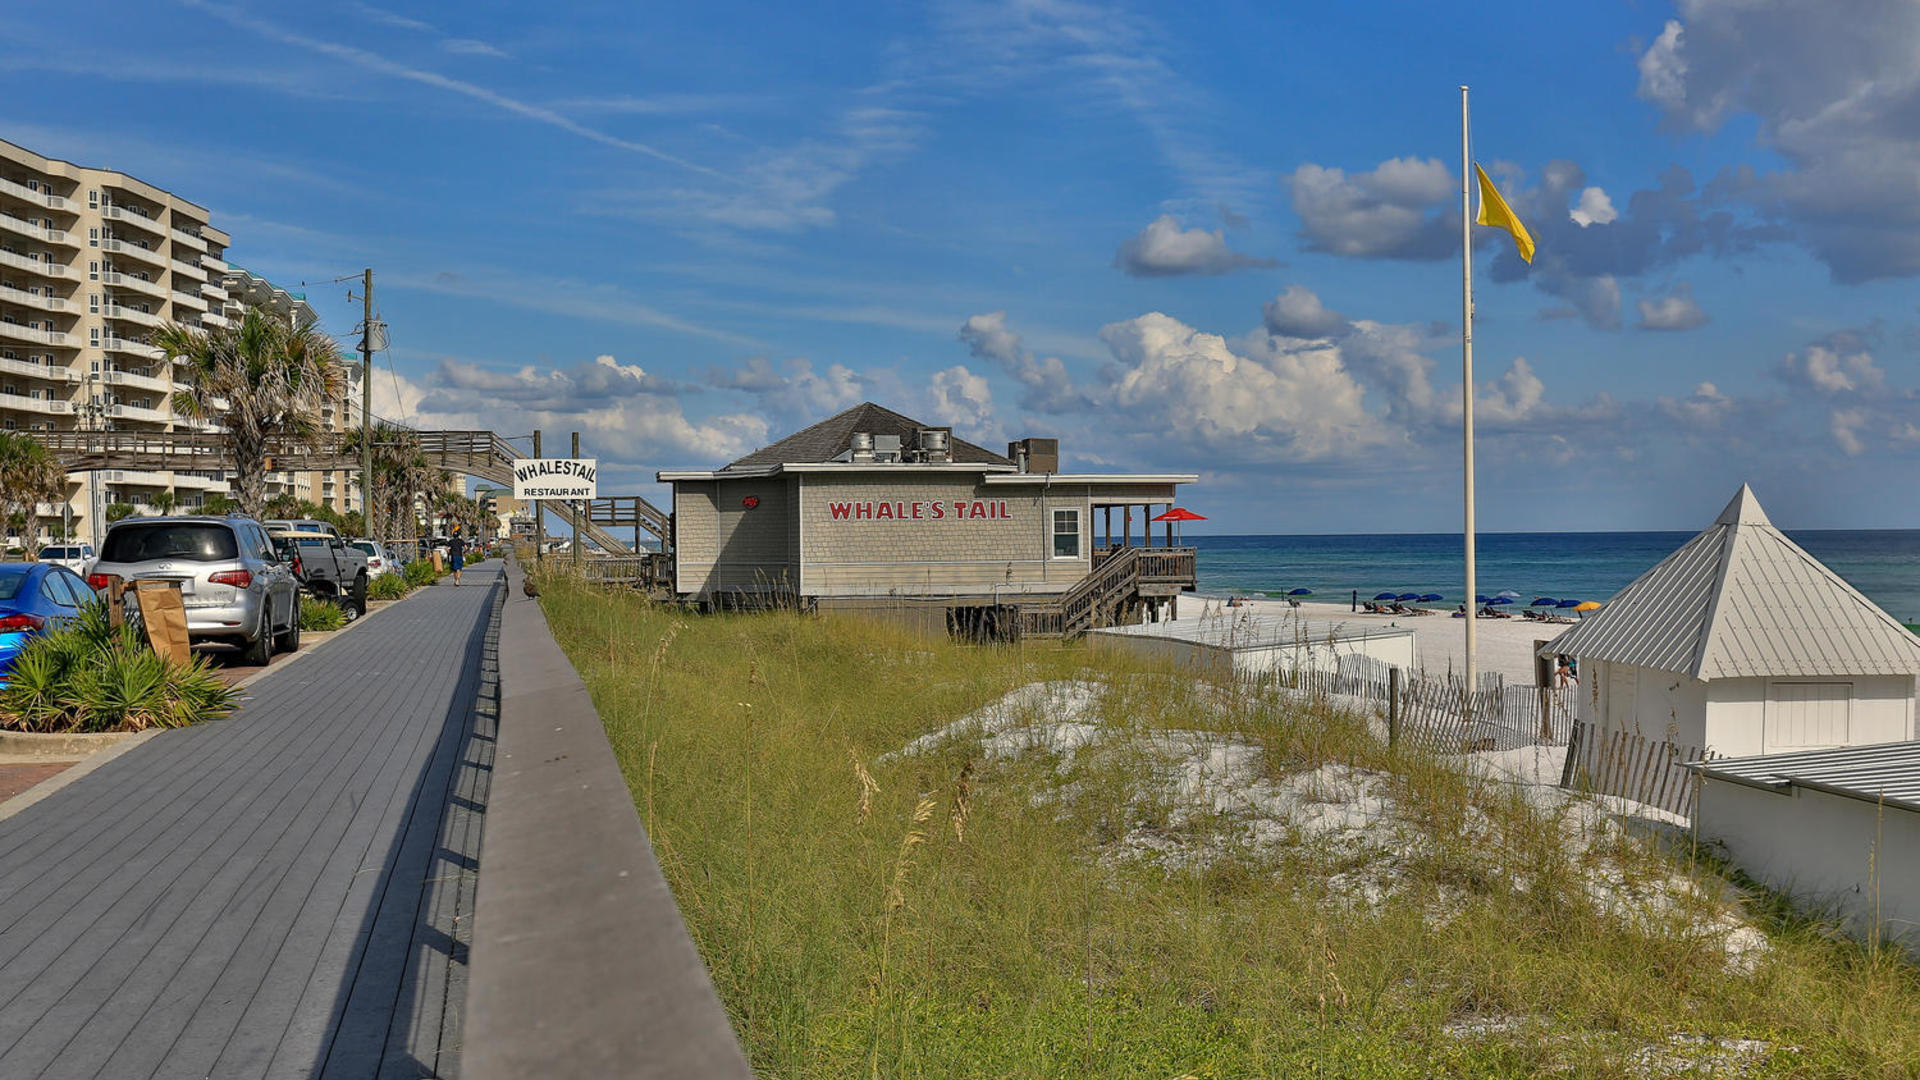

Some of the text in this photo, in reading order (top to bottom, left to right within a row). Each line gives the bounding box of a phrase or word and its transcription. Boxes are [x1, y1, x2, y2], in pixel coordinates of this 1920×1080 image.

[515, 460, 596, 483] WHALESTAIL
[524, 488, 590, 496] RESTAURANT
[829, 501, 1012, 520] WHALE'S TAIL
